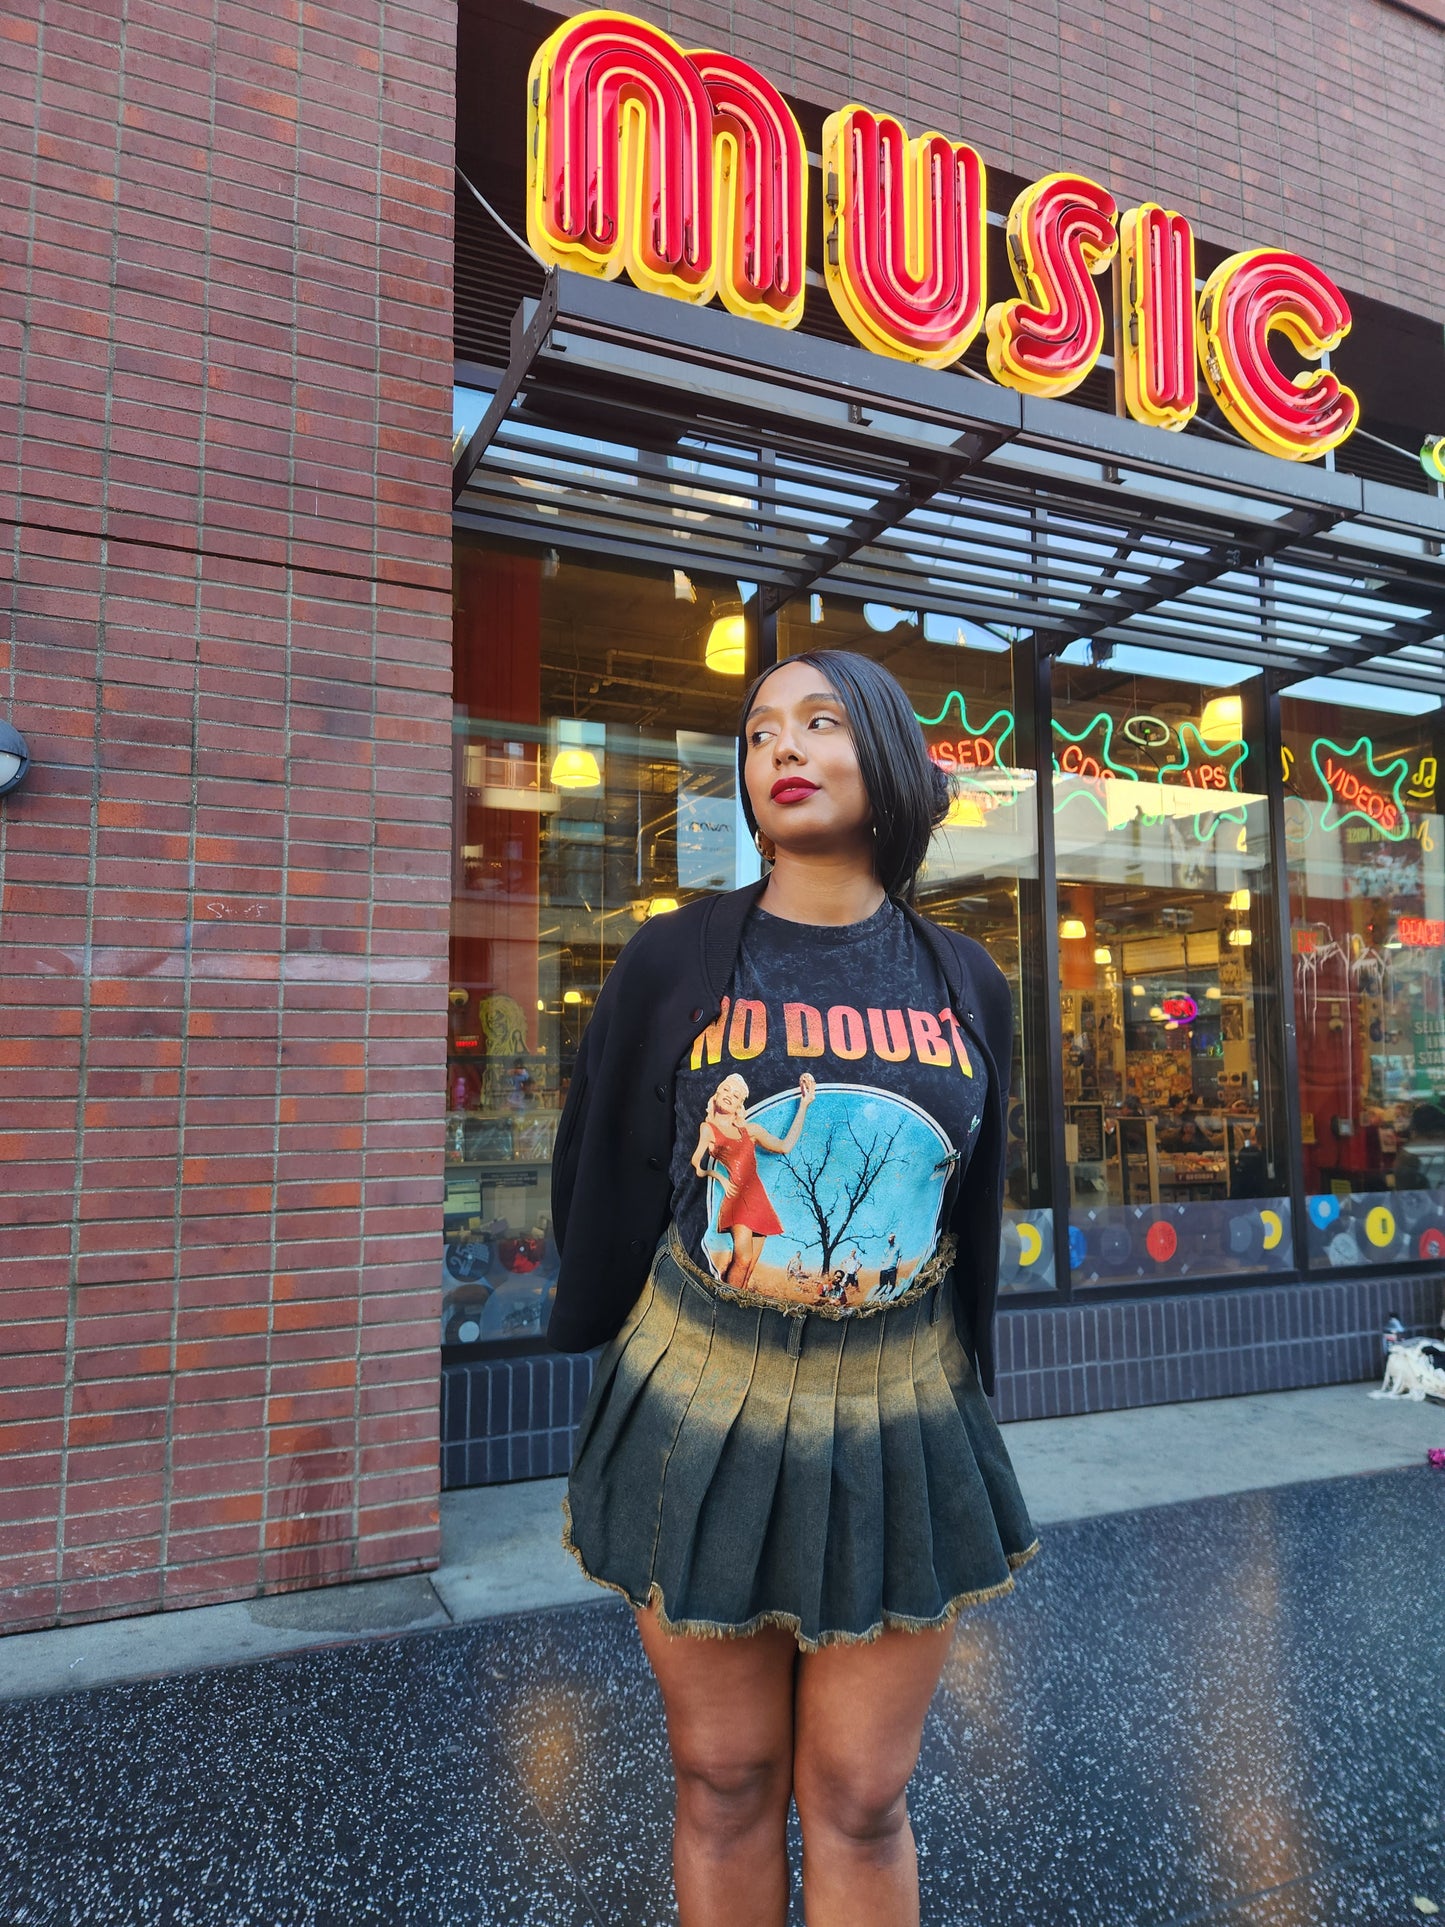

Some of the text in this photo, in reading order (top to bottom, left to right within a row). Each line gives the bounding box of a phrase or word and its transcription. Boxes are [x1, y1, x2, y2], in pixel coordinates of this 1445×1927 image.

[526, 8, 1361, 462] MUSIC
[1325, 757, 1398, 831] VIDEOS
[689, 995, 974, 1080] NO DOUBT
